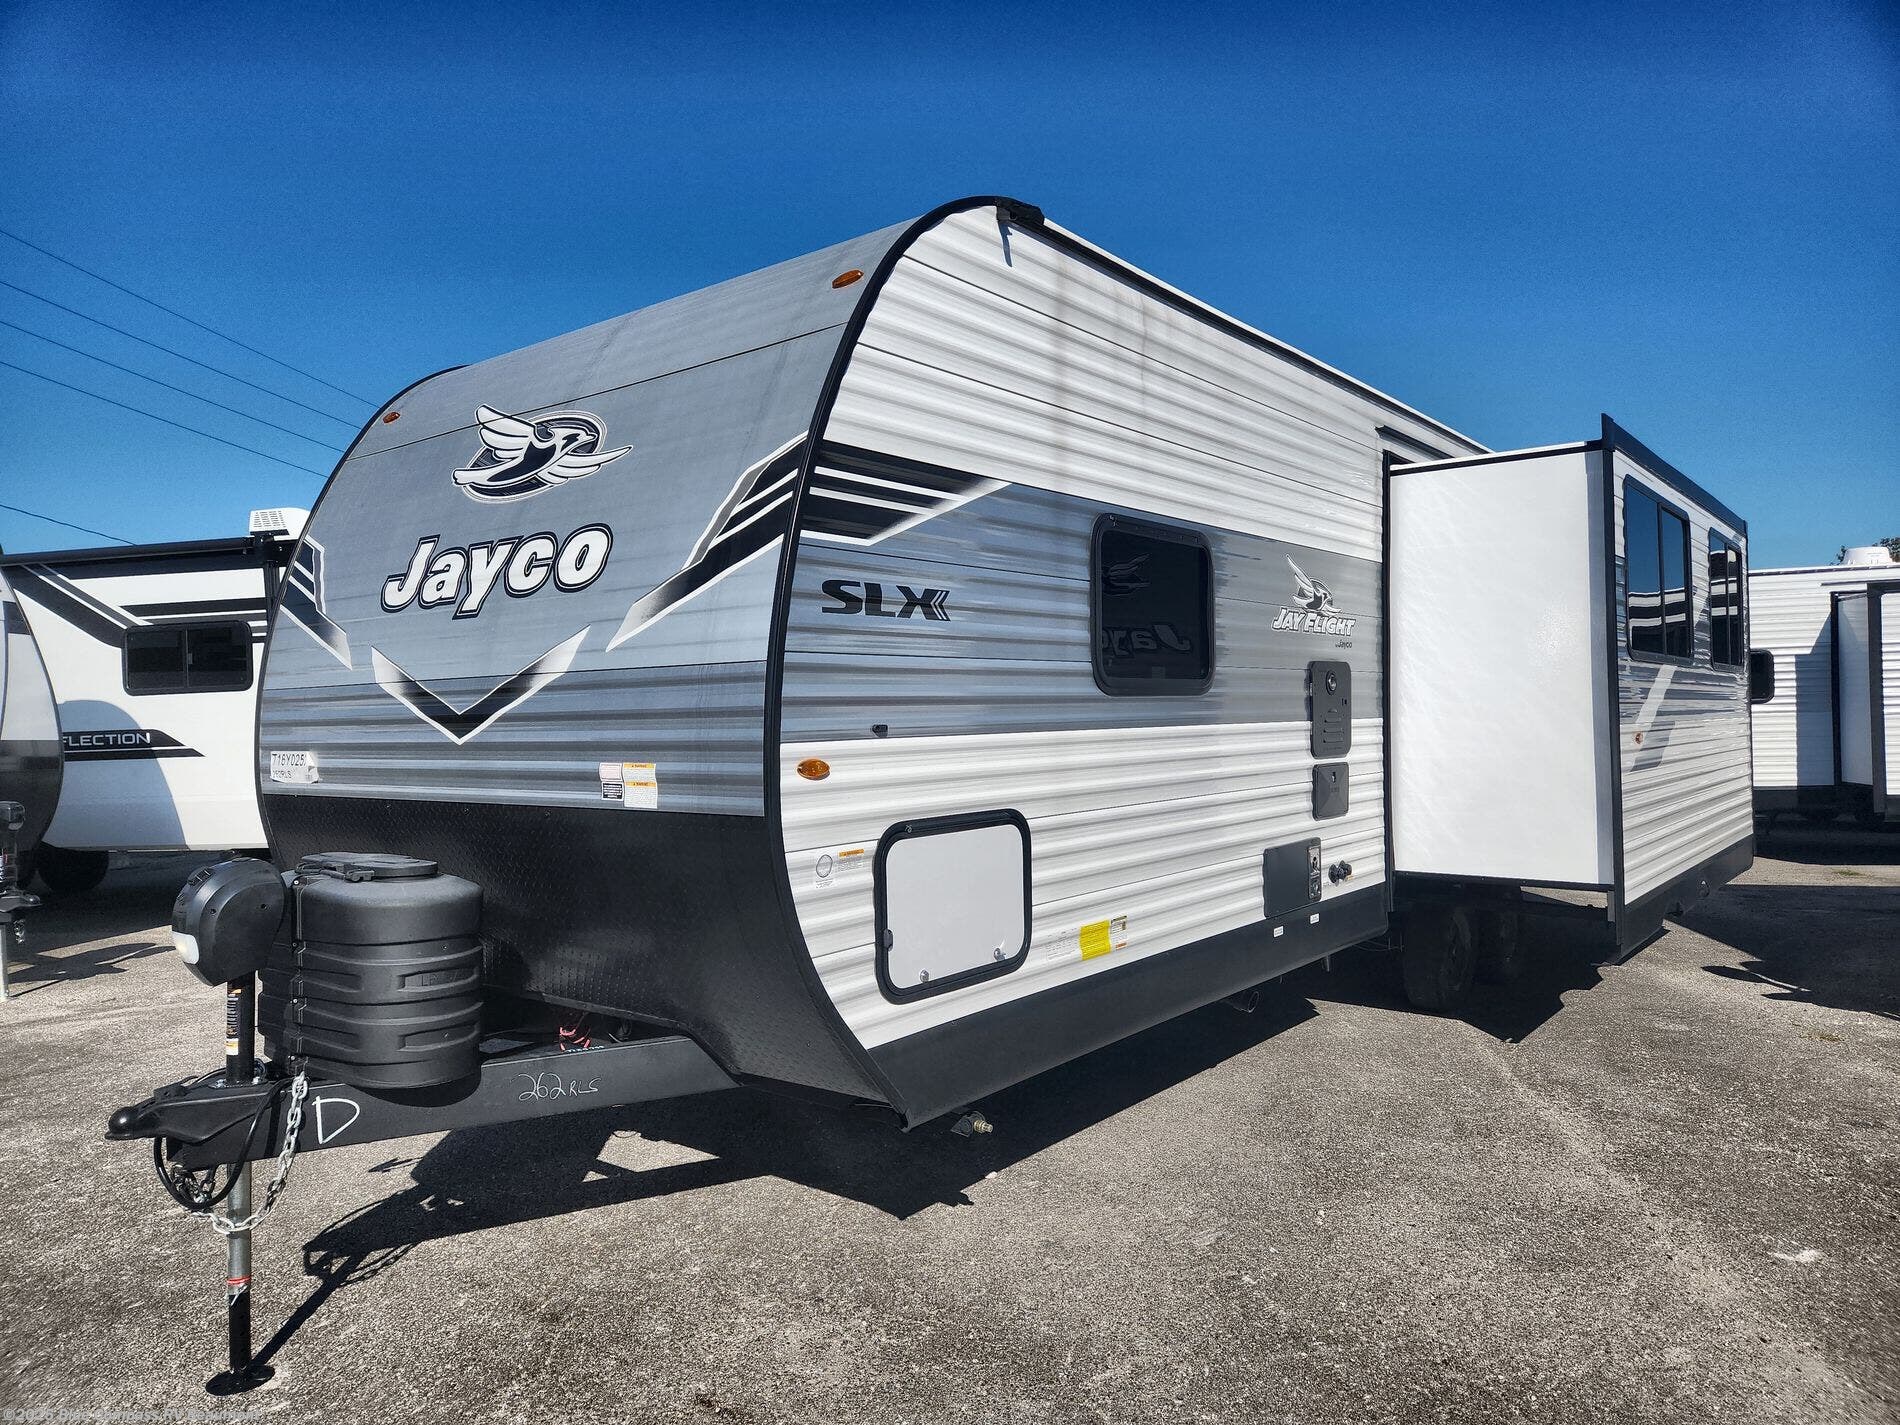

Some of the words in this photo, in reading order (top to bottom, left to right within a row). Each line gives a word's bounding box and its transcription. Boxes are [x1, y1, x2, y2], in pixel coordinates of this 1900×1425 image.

[381, 522, 614, 620] Jayco
[821, 579, 951, 621] SLX
[1272, 606, 1307, 632] JAY
[1302, 611, 1357, 637] FLIGHT
[312, 1096, 360, 1144] D
